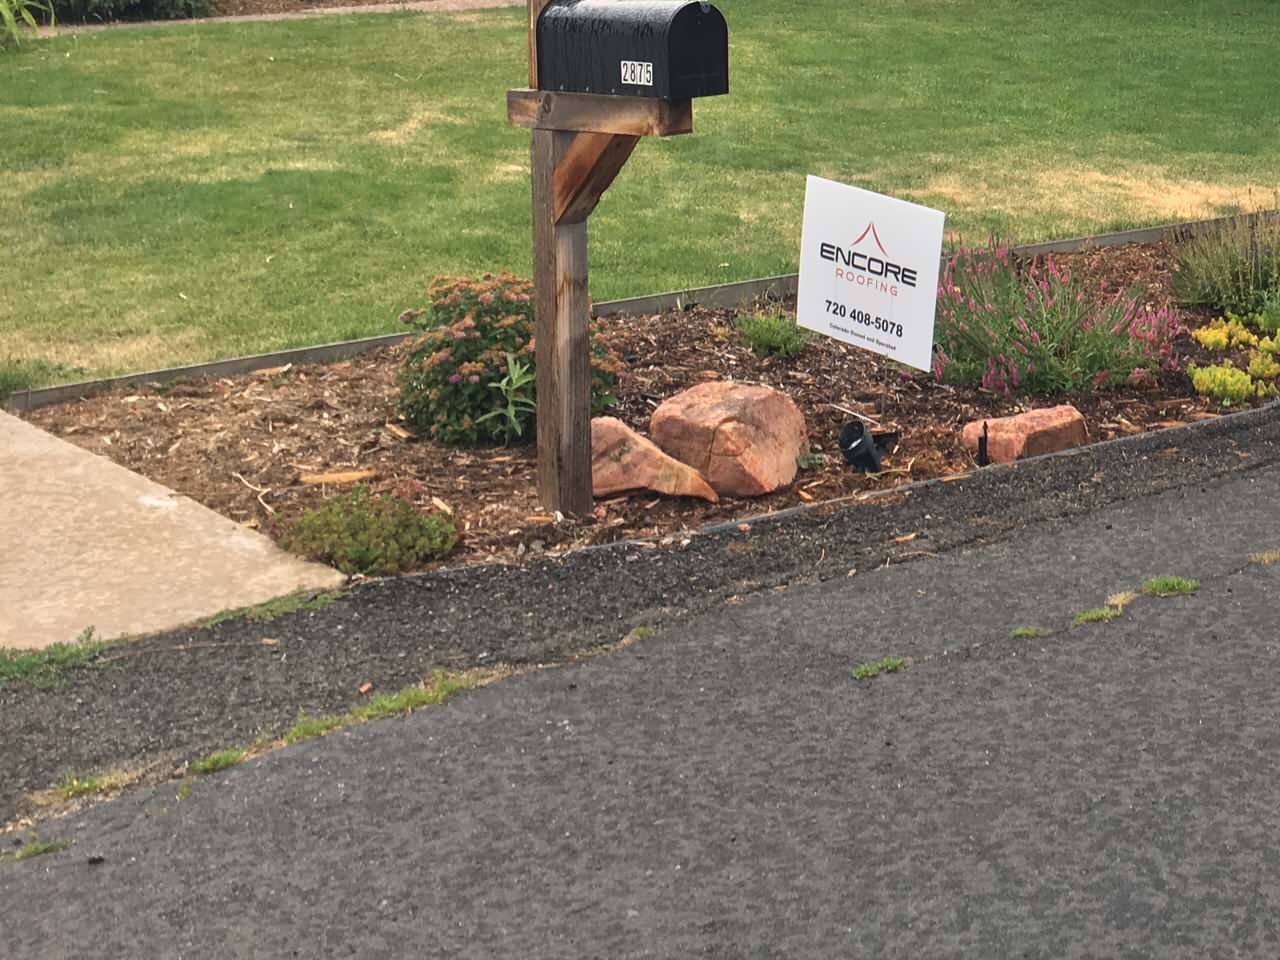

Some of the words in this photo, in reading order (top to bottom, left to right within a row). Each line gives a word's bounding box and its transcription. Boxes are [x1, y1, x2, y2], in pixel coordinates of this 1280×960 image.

[622, 62, 652, 83] 2875
[820, 242, 917, 287] ENCORE
[835, 268, 898, 296] ROOFING
[825, 299, 846, 317] 720
[850, 308, 904, 337] 408-5078
